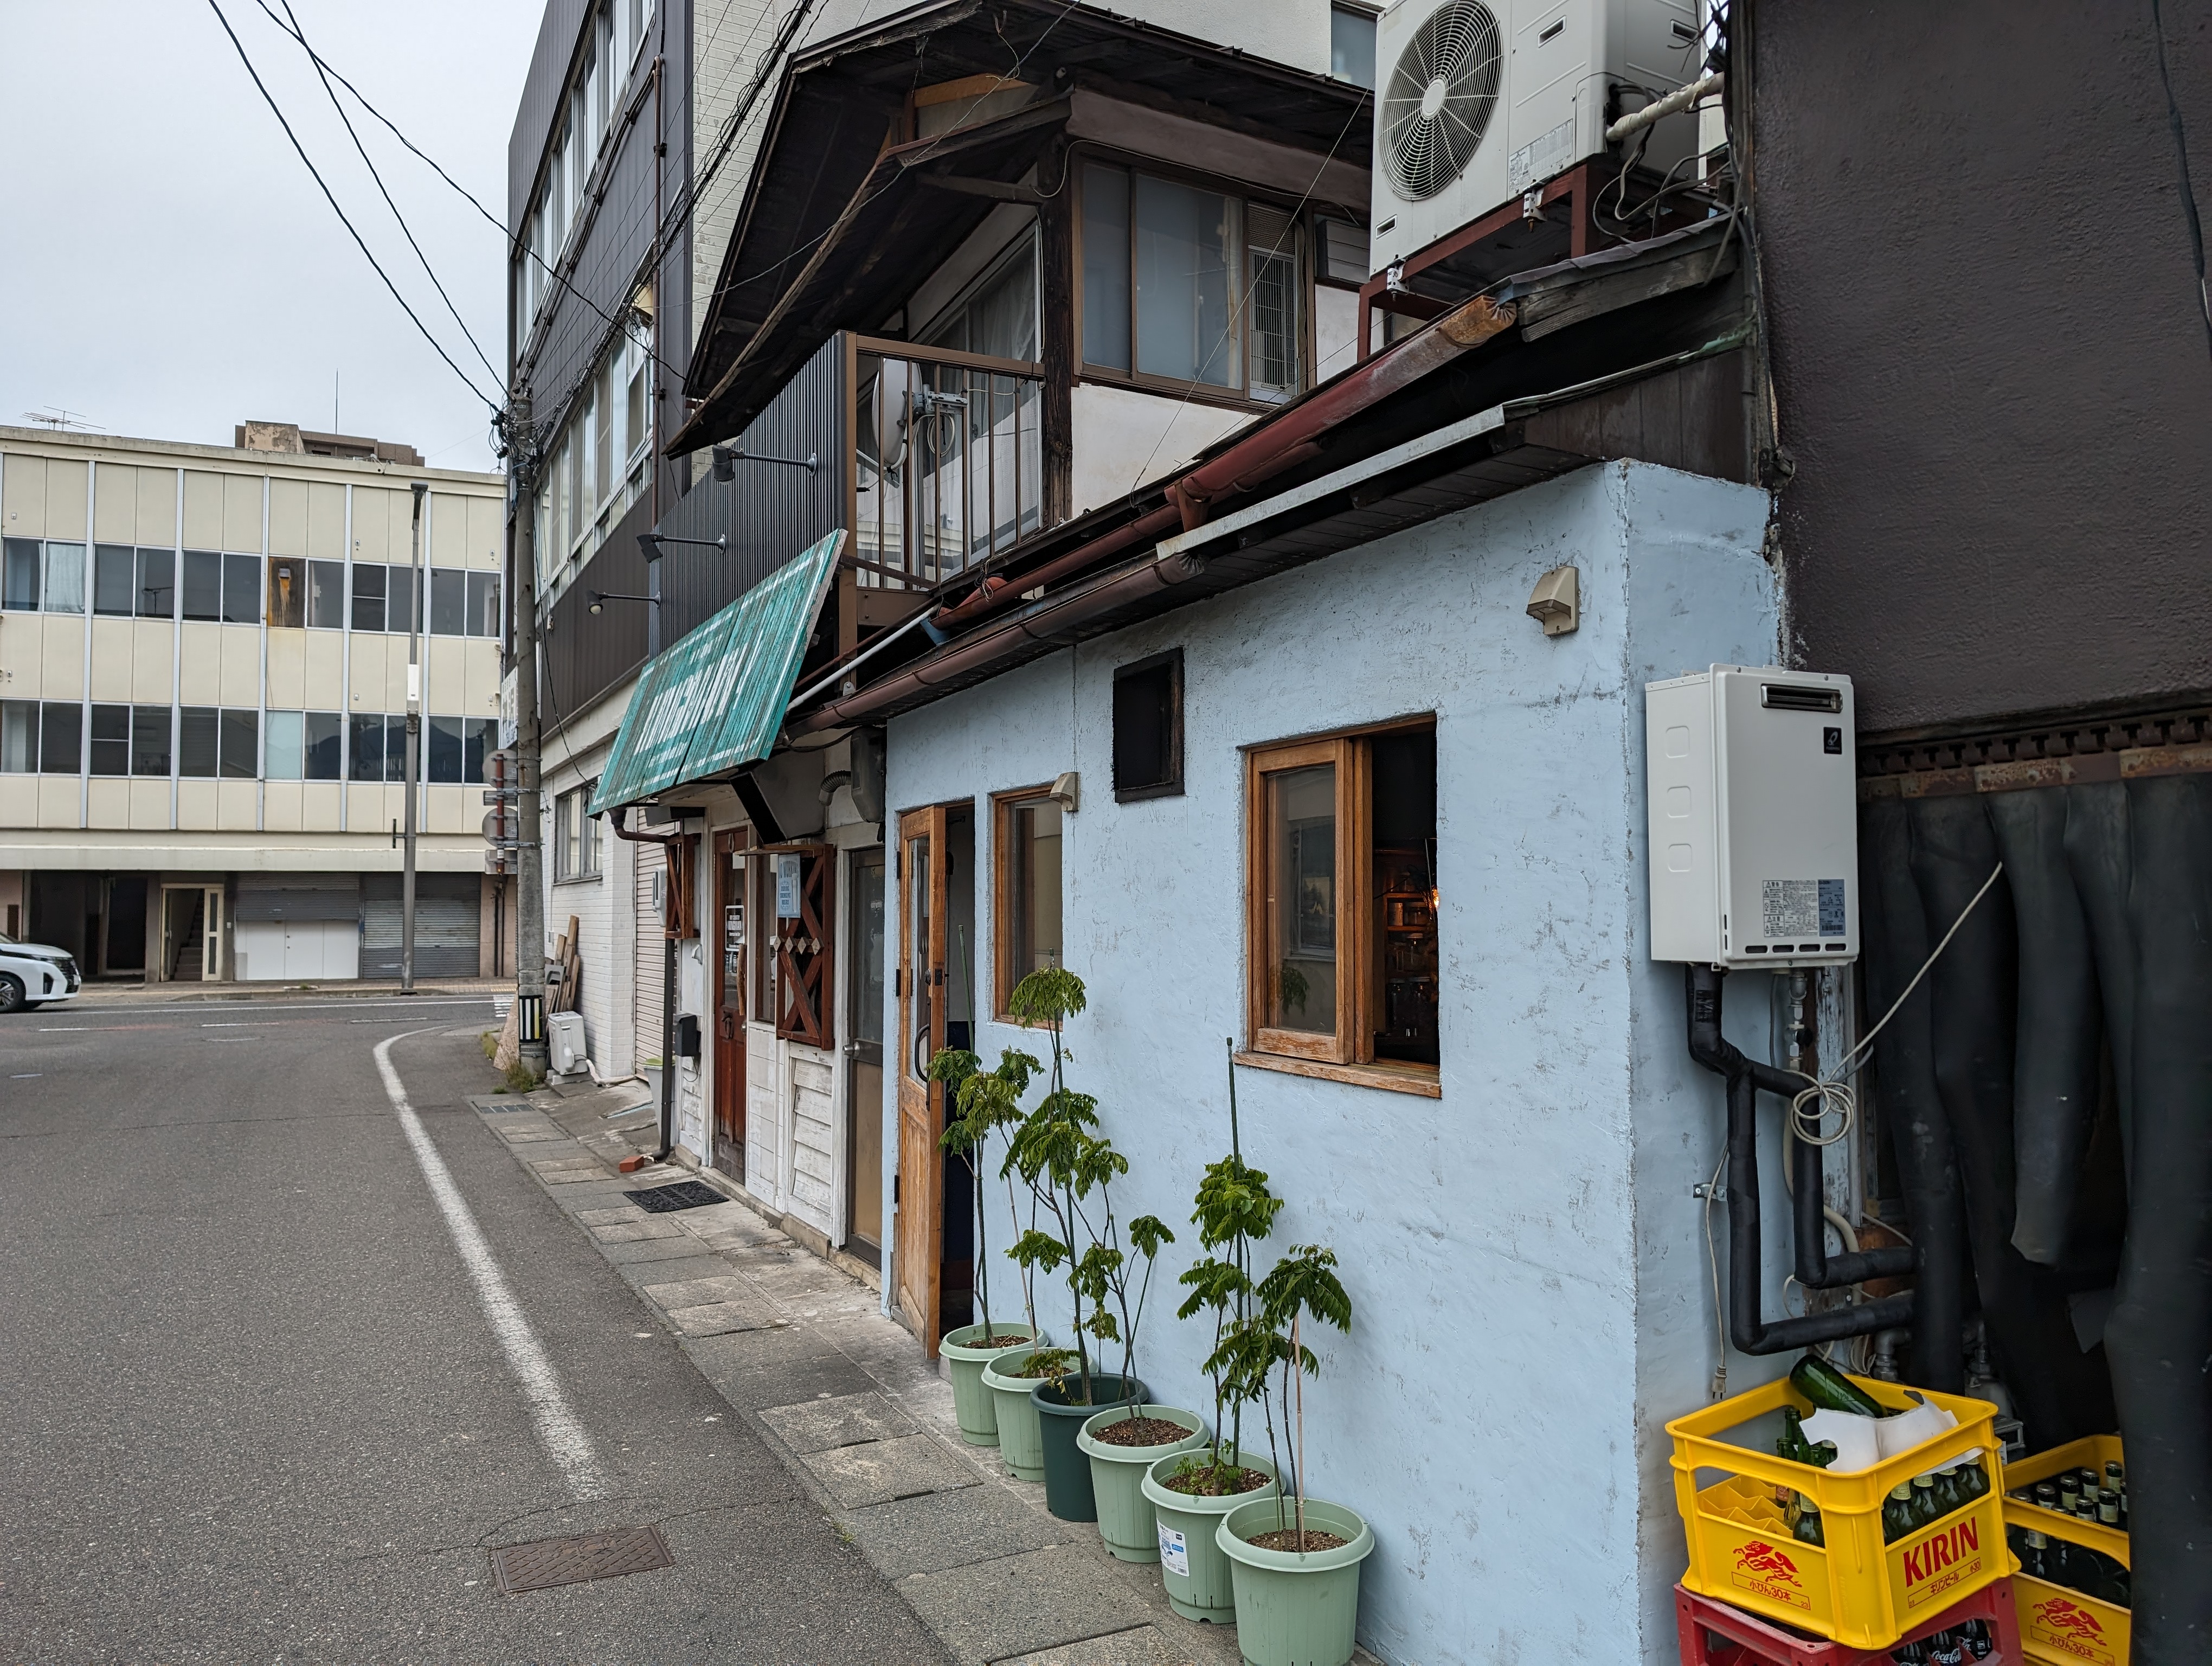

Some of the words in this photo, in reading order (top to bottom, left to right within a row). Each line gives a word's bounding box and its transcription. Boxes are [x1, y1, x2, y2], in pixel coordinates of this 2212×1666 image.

[633, 640, 749, 756] KINGMAN
[1903, 1516, 1979, 1588] KIRIN
[1970, 1561, 1980, 1573] 小30
[1750, 1580, 1791, 1601] 小びん30本
[1930, 1572, 1959, 1594] キリンビール
[2049, 1635, 2094, 1658] 小びん30本
